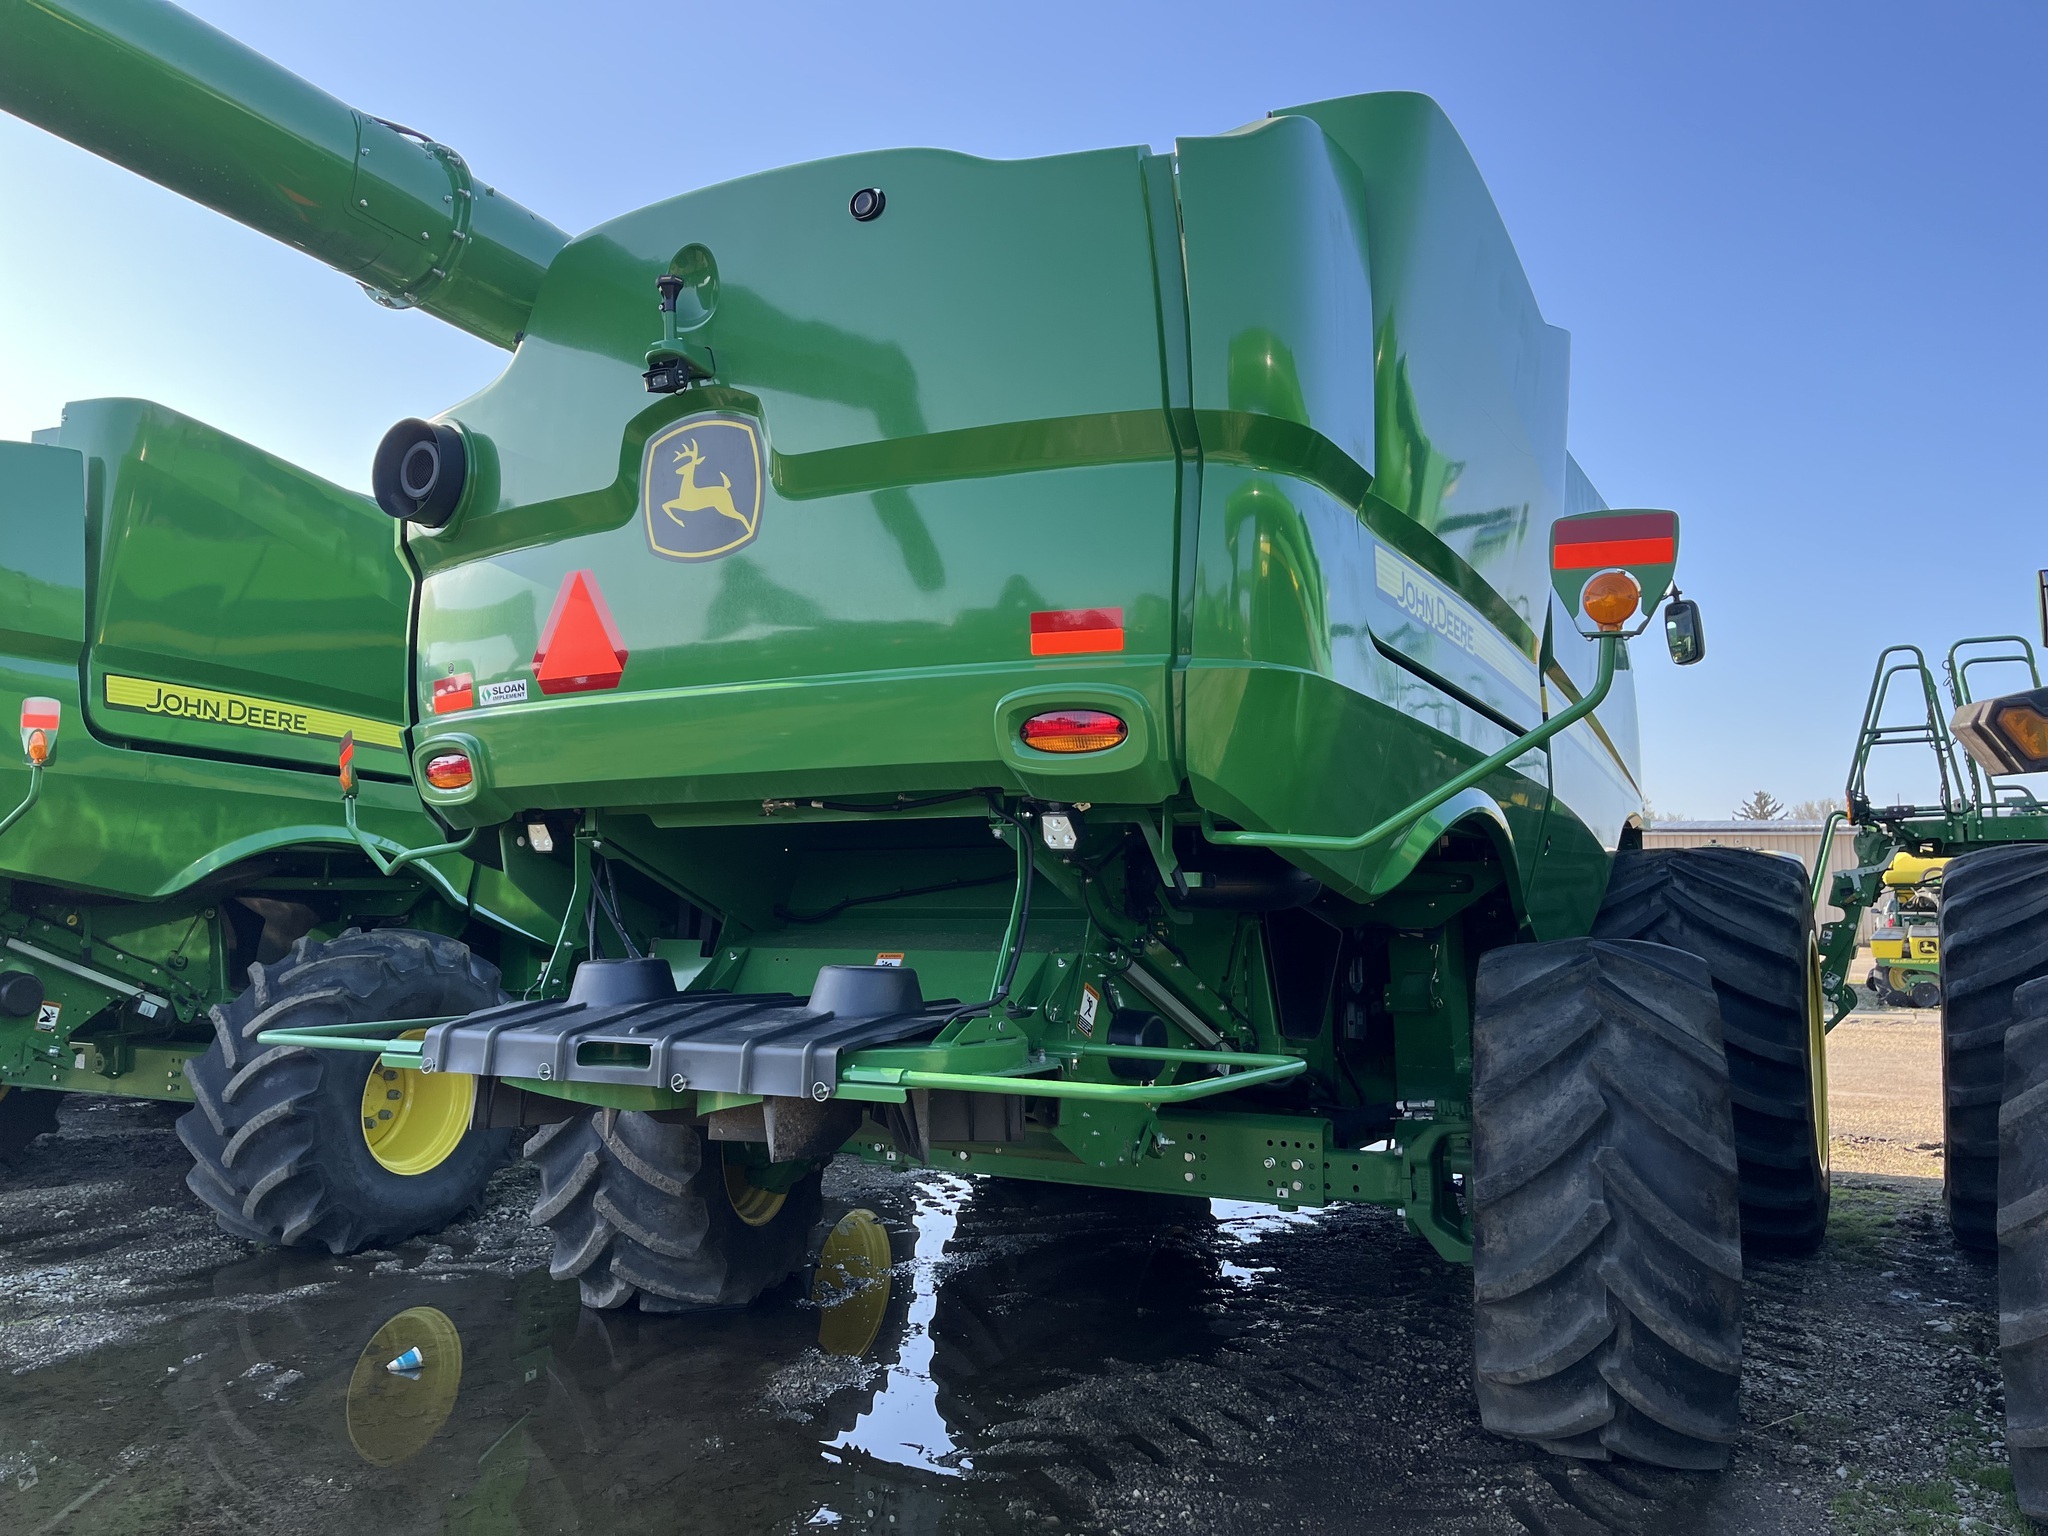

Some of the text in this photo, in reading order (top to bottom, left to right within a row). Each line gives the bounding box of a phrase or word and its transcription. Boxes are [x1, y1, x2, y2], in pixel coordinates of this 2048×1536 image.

[1397, 571, 1475, 653] JOHN DEERE
[492, 683, 525, 695] SLOAN
[492, 692, 525, 701] IMPLEMENT
[146, 688, 308, 732] JOHN DEERE
